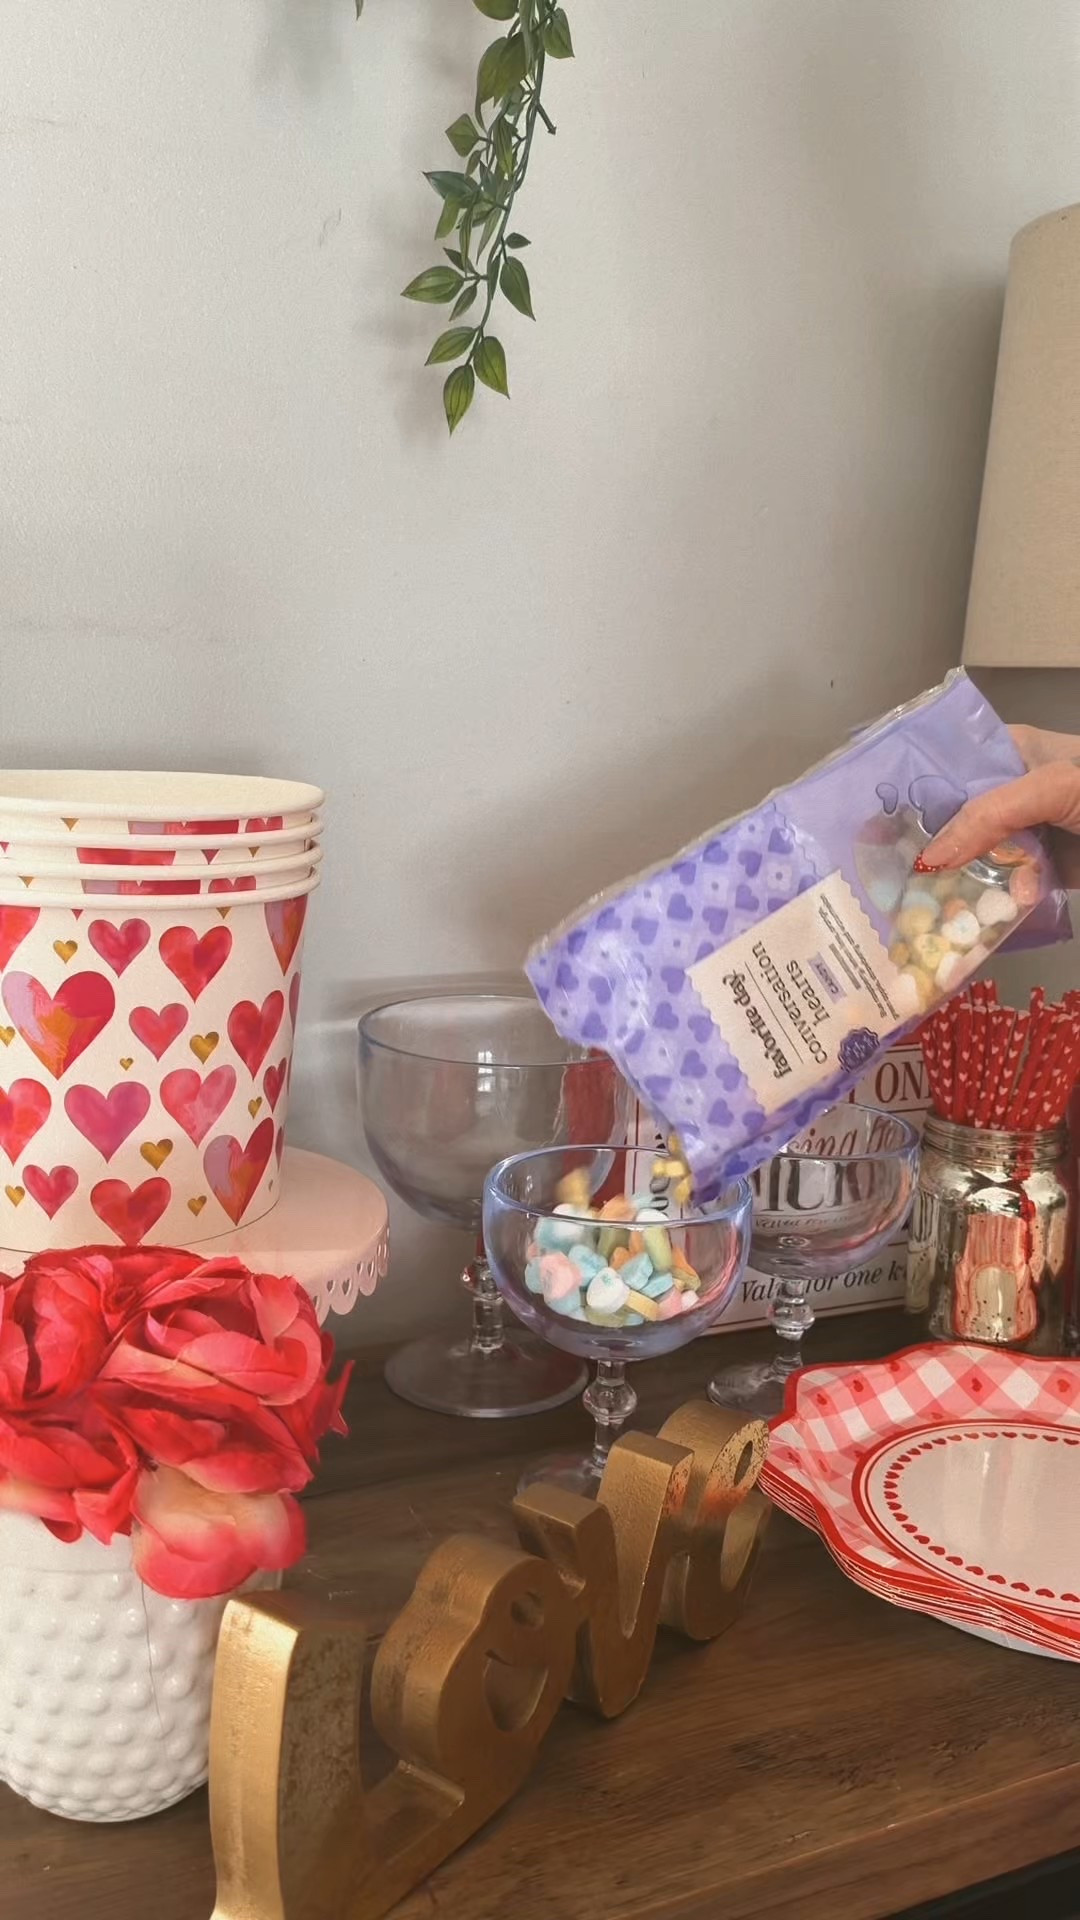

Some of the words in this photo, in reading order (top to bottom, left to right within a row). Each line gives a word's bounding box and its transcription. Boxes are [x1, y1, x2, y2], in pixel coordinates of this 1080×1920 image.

[751, 940, 828, 1065] conversation
[786, 959, 831, 1026] hearts
[744, 1005, 793, 1080] favorite
[843, 1266, 882, 1288] one
